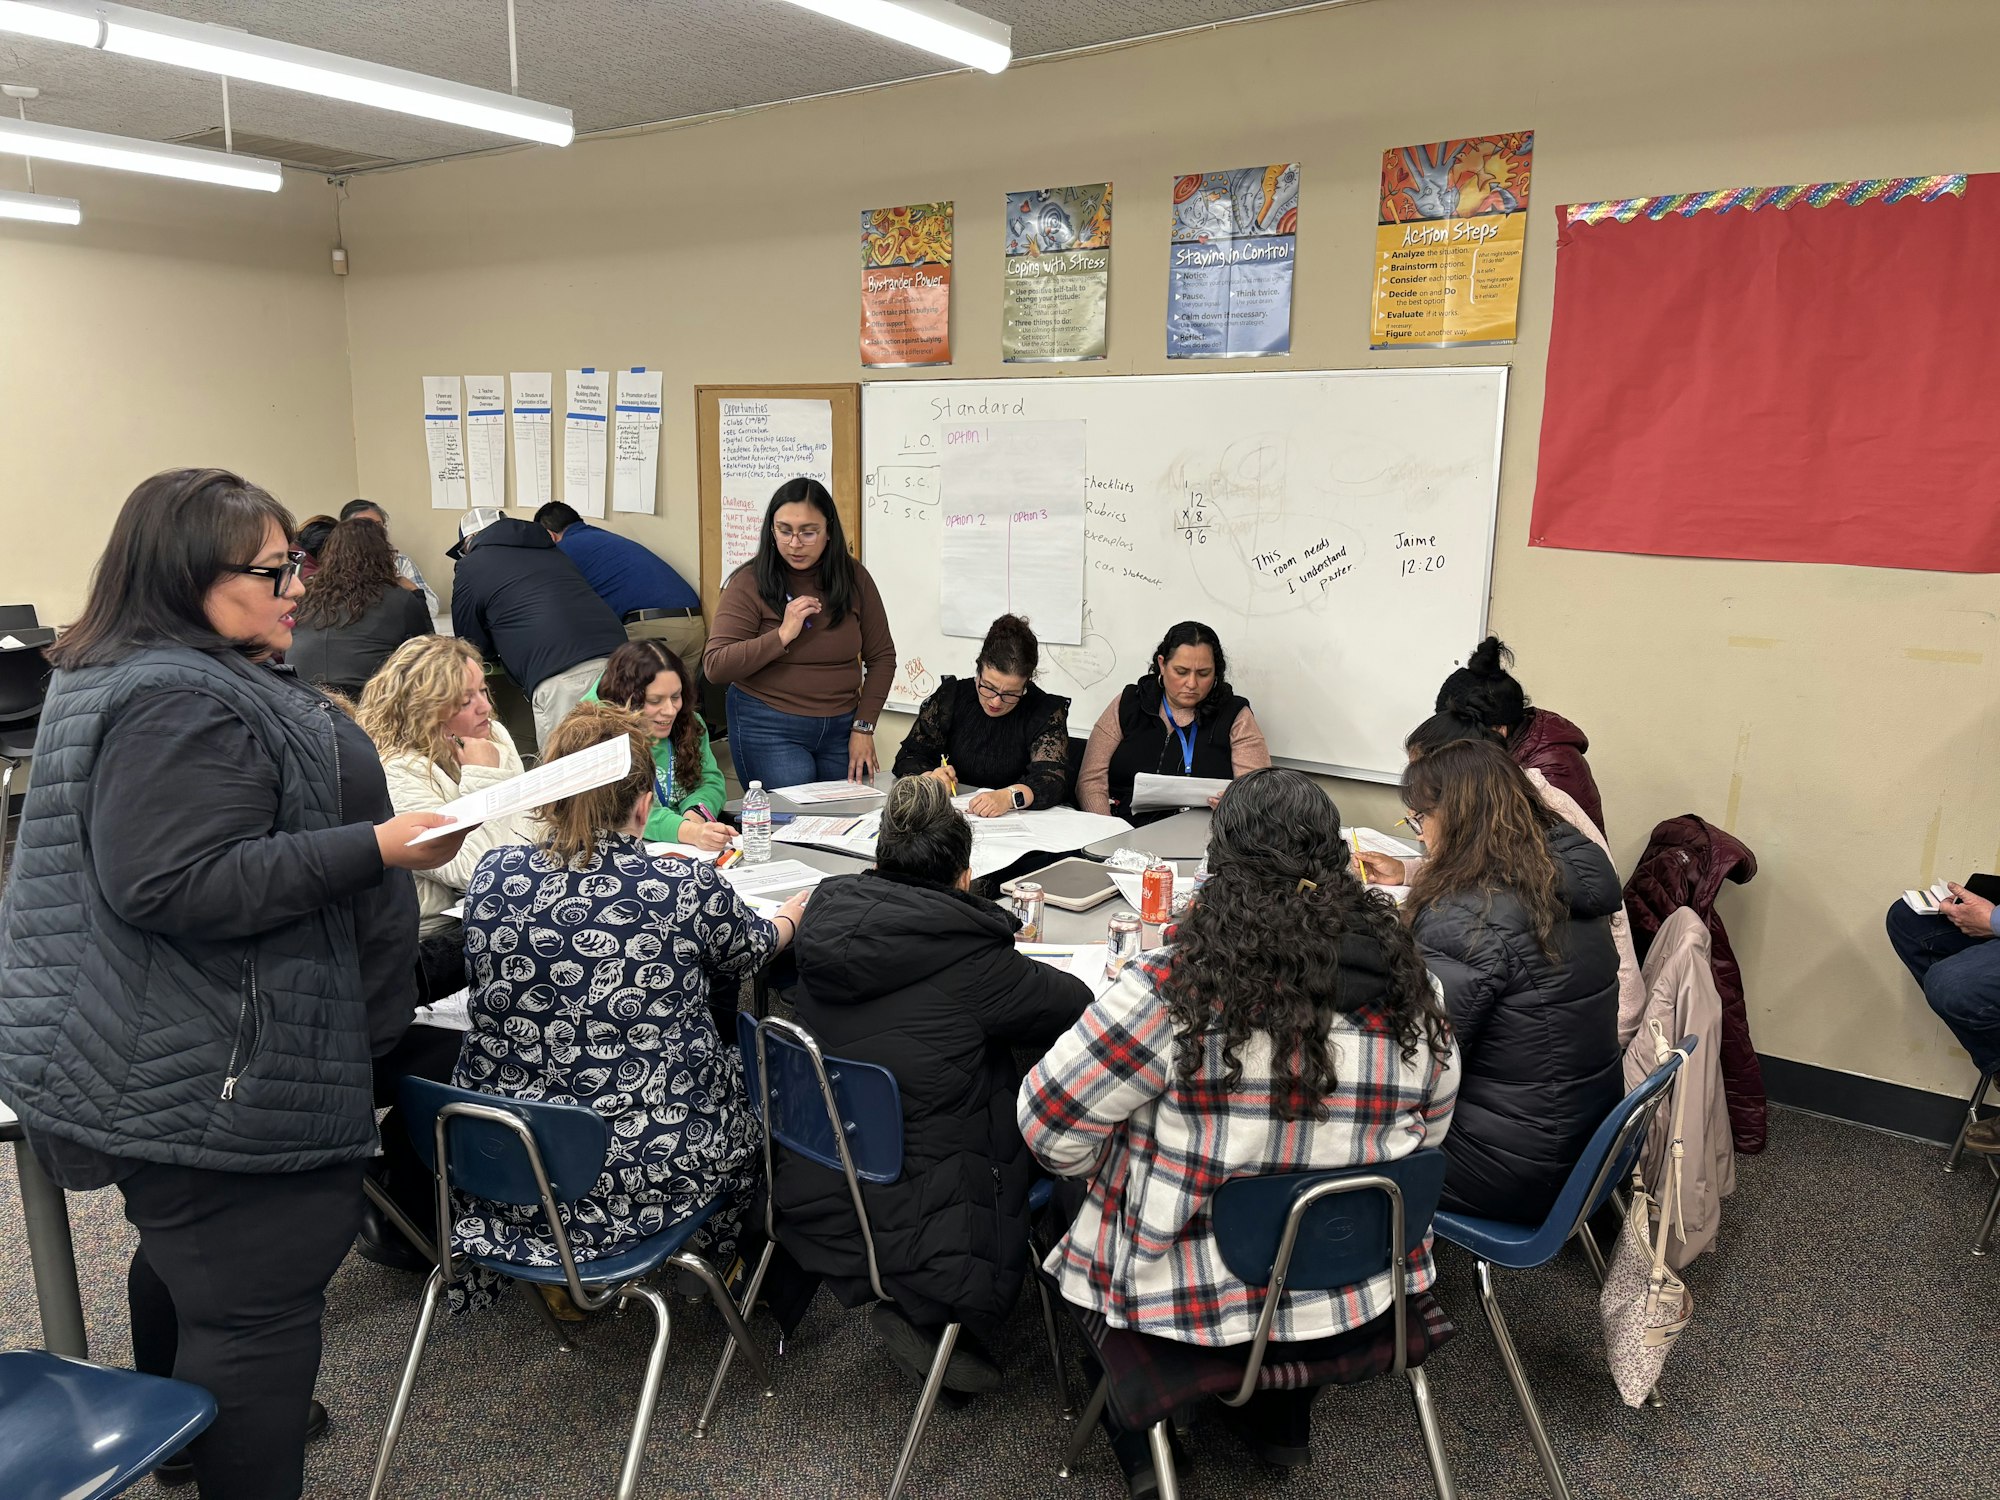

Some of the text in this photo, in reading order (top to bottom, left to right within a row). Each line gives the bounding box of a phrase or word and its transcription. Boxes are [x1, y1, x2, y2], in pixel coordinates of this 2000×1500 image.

[1402, 221, 1499, 248] Action Steps
[1176, 243, 1289, 269] Staying in Control
[1392, 250, 1425, 260] Analyze
[1008, 254, 1105, 278] Coping with Stress
[1391, 261, 1466, 271] Brainstorm options.
[868, 272, 943, 295] Bystander Power
[1390, 275, 1427, 284] Consider
[1028, 287, 1052, 295] positive
[1389, 289, 1417, 298] Decide
[1231, 311, 1268, 319] necessary.
[1386, 330, 1412, 339] Figure
[724, 403, 768, 415] Opportunities
[931, 397, 1025, 420] Standard
[726, 437, 743, 445] Digital
[745, 436, 774, 444] Citizenship
[986, 428, 989, 442] 1
[758, 463, 780, 472] building
[884, 475, 890, 489] 1.
[723, 496, 754, 512] Challenges
[1191, 491, 1206, 510] 12
[1040, 509, 1047, 522] 3
[1085, 501, 1126, 523] Rubrics
[1196, 511, 1202, 522] 8
[979, 514, 987, 526] 2
[1394, 532, 1436, 549] Jaime
[1252, 549, 1281, 571] This
[1273, 538, 1330, 576] room needs
[1287, 546, 1347, 594] I understand
[1402, 555, 1445, 577] 12:20
